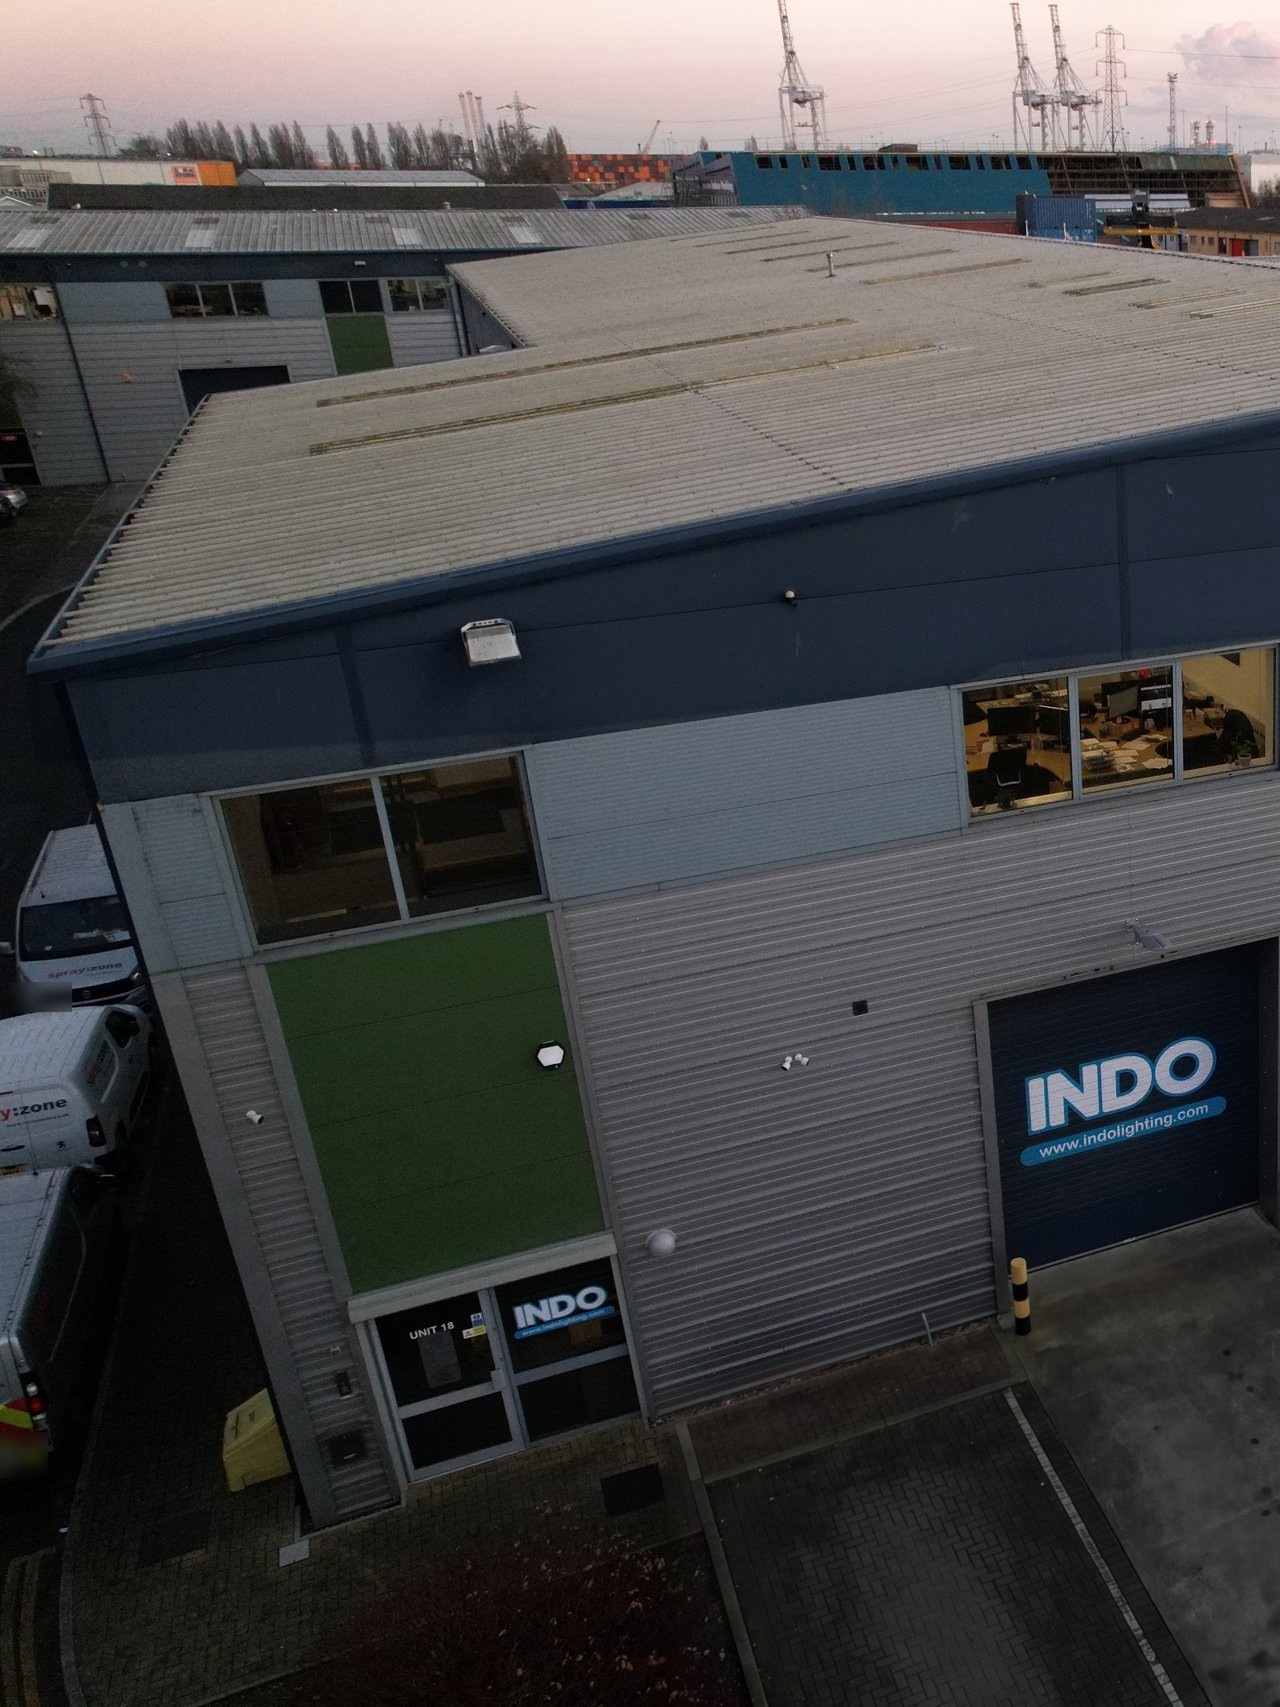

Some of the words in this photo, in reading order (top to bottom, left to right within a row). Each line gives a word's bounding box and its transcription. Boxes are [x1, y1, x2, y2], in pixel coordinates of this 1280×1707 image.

[1027, 1037, 1216, 1134] INDO
[1039, 1104, 1209, 1159] www.indolighting.com
[409, 1324, 438, 1340] UNIT
[439, 1321, 455, 1332] 18
[512, 1285, 607, 1330] INDO
